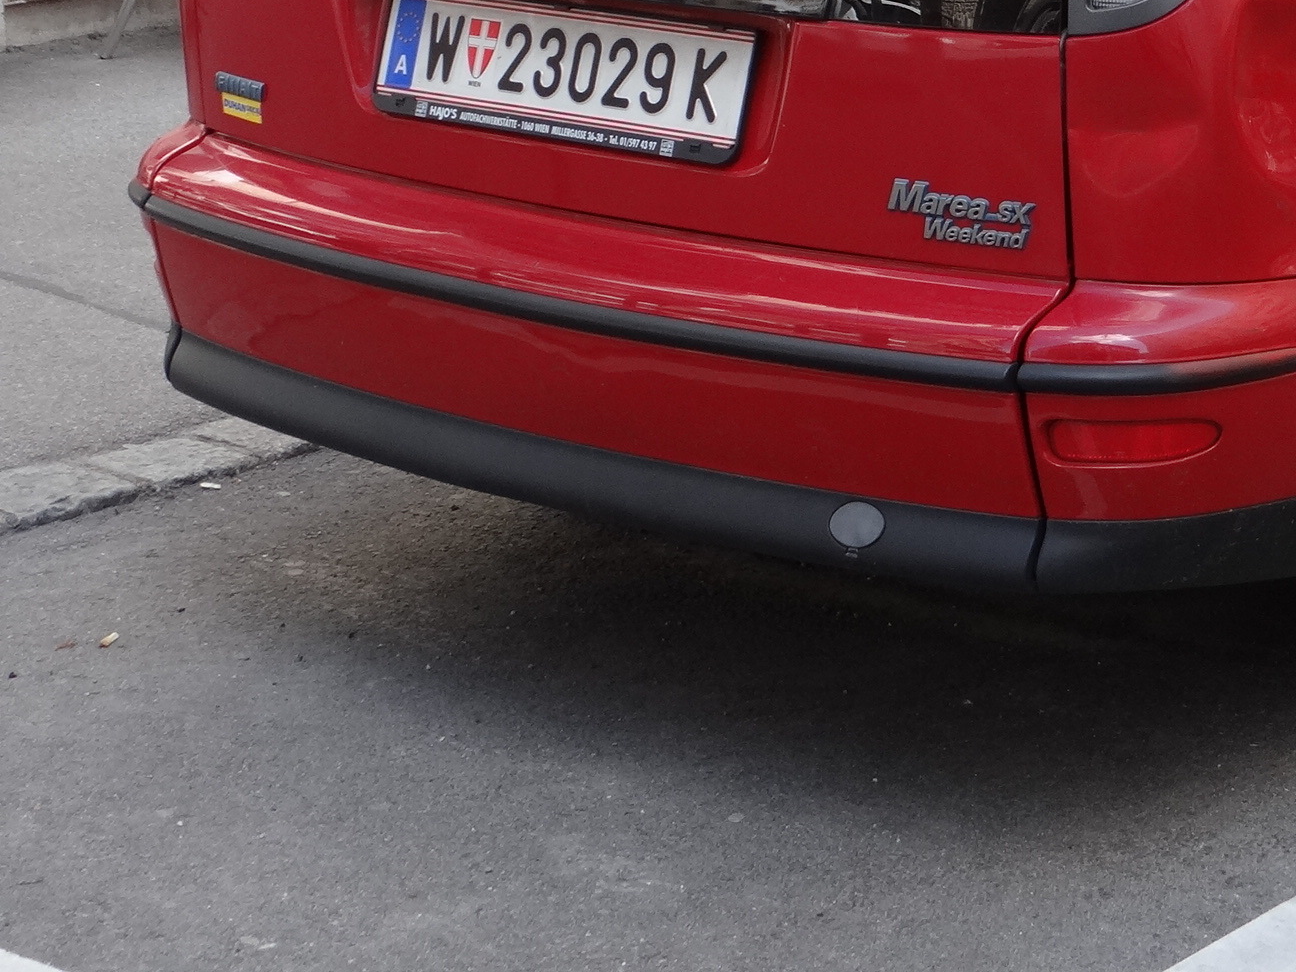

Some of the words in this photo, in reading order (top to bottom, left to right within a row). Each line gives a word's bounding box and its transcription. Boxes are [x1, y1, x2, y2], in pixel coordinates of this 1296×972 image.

[394, 54, 408, 76] A
[426, 12, 465, 83] W
[497, 22, 676, 115] 23029
[685, 47, 727, 124] K
[521, 121, 535, 131] 1060
[535, 123, 550, 134] WIEN
[619, 136, 640, 148] 01/597
[640, 138, 649, 150] 43
[649, 141, 658, 151] 97
[887, 178, 990, 221] Marea
[923, 215, 1031, 250] Weekend
